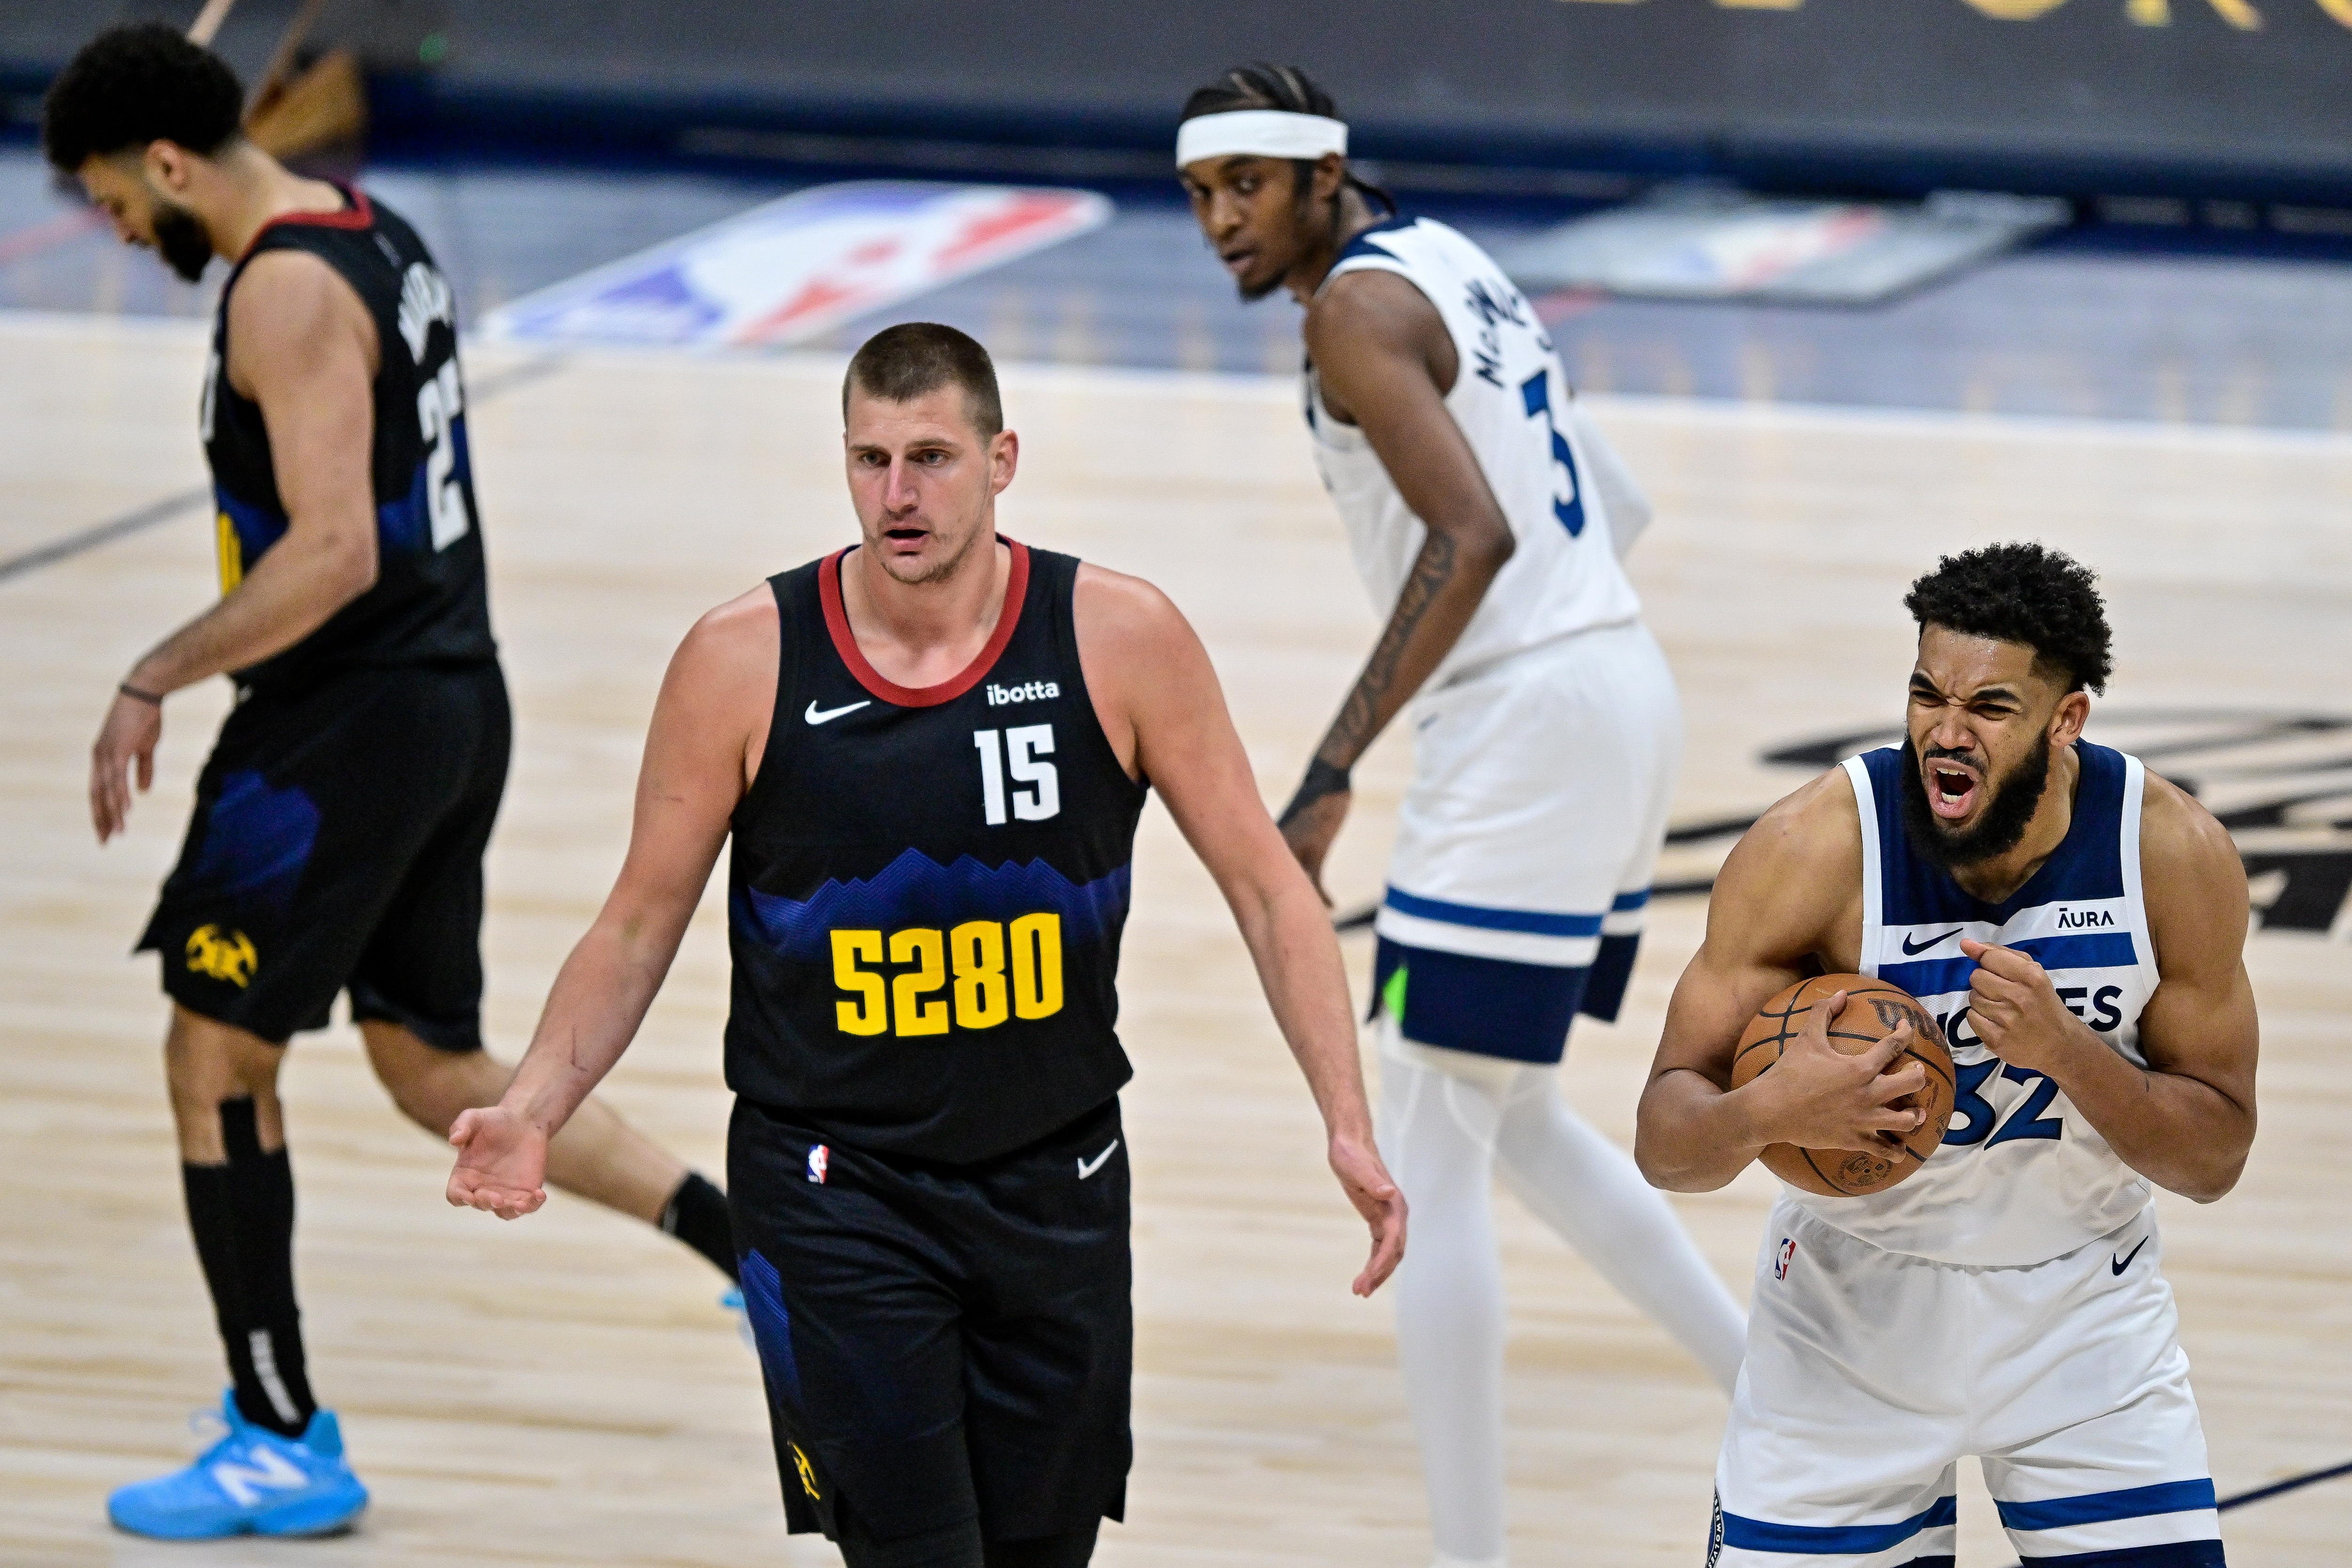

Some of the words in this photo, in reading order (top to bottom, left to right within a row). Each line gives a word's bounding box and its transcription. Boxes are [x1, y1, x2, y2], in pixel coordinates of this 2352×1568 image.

[1520, 369, 1585, 537] 3
[987, 681, 1060, 706] ibotta
[974, 724, 1060, 825] 15
[830, 913, 1064, 1037] 5280
[1940, 1057, 2064, 1151] 32
